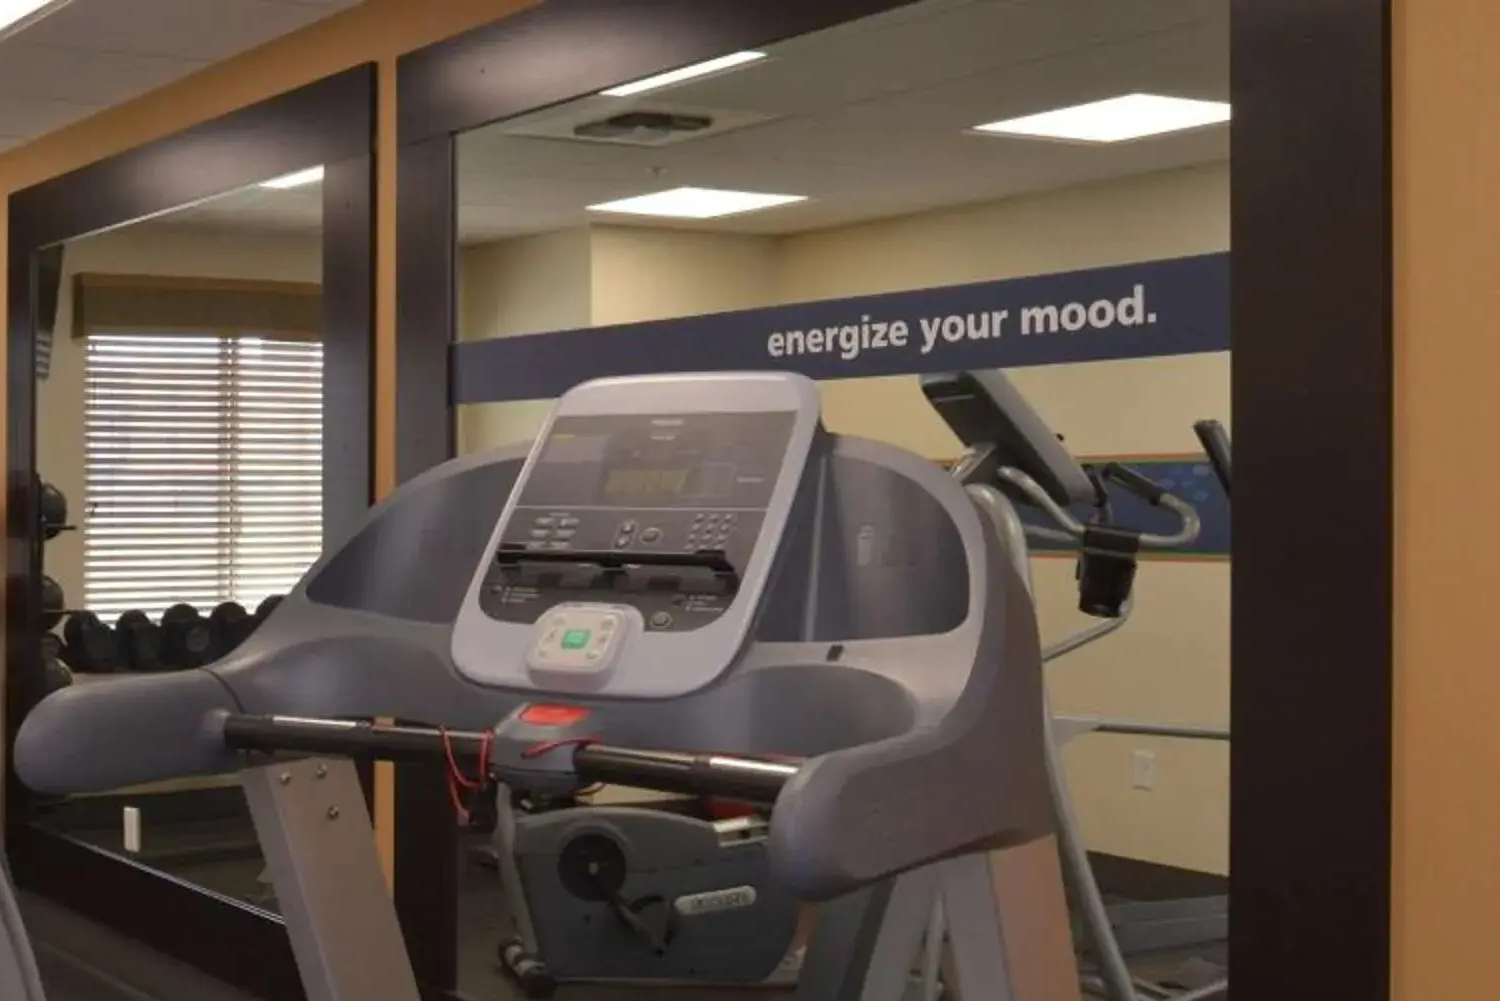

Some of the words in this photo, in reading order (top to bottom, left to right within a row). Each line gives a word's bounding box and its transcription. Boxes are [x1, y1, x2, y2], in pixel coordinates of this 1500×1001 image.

[767, 314, 909, 360] energize
[920, 308, 1008, 355] your
[1020, 284, 1158, 336] mood.
